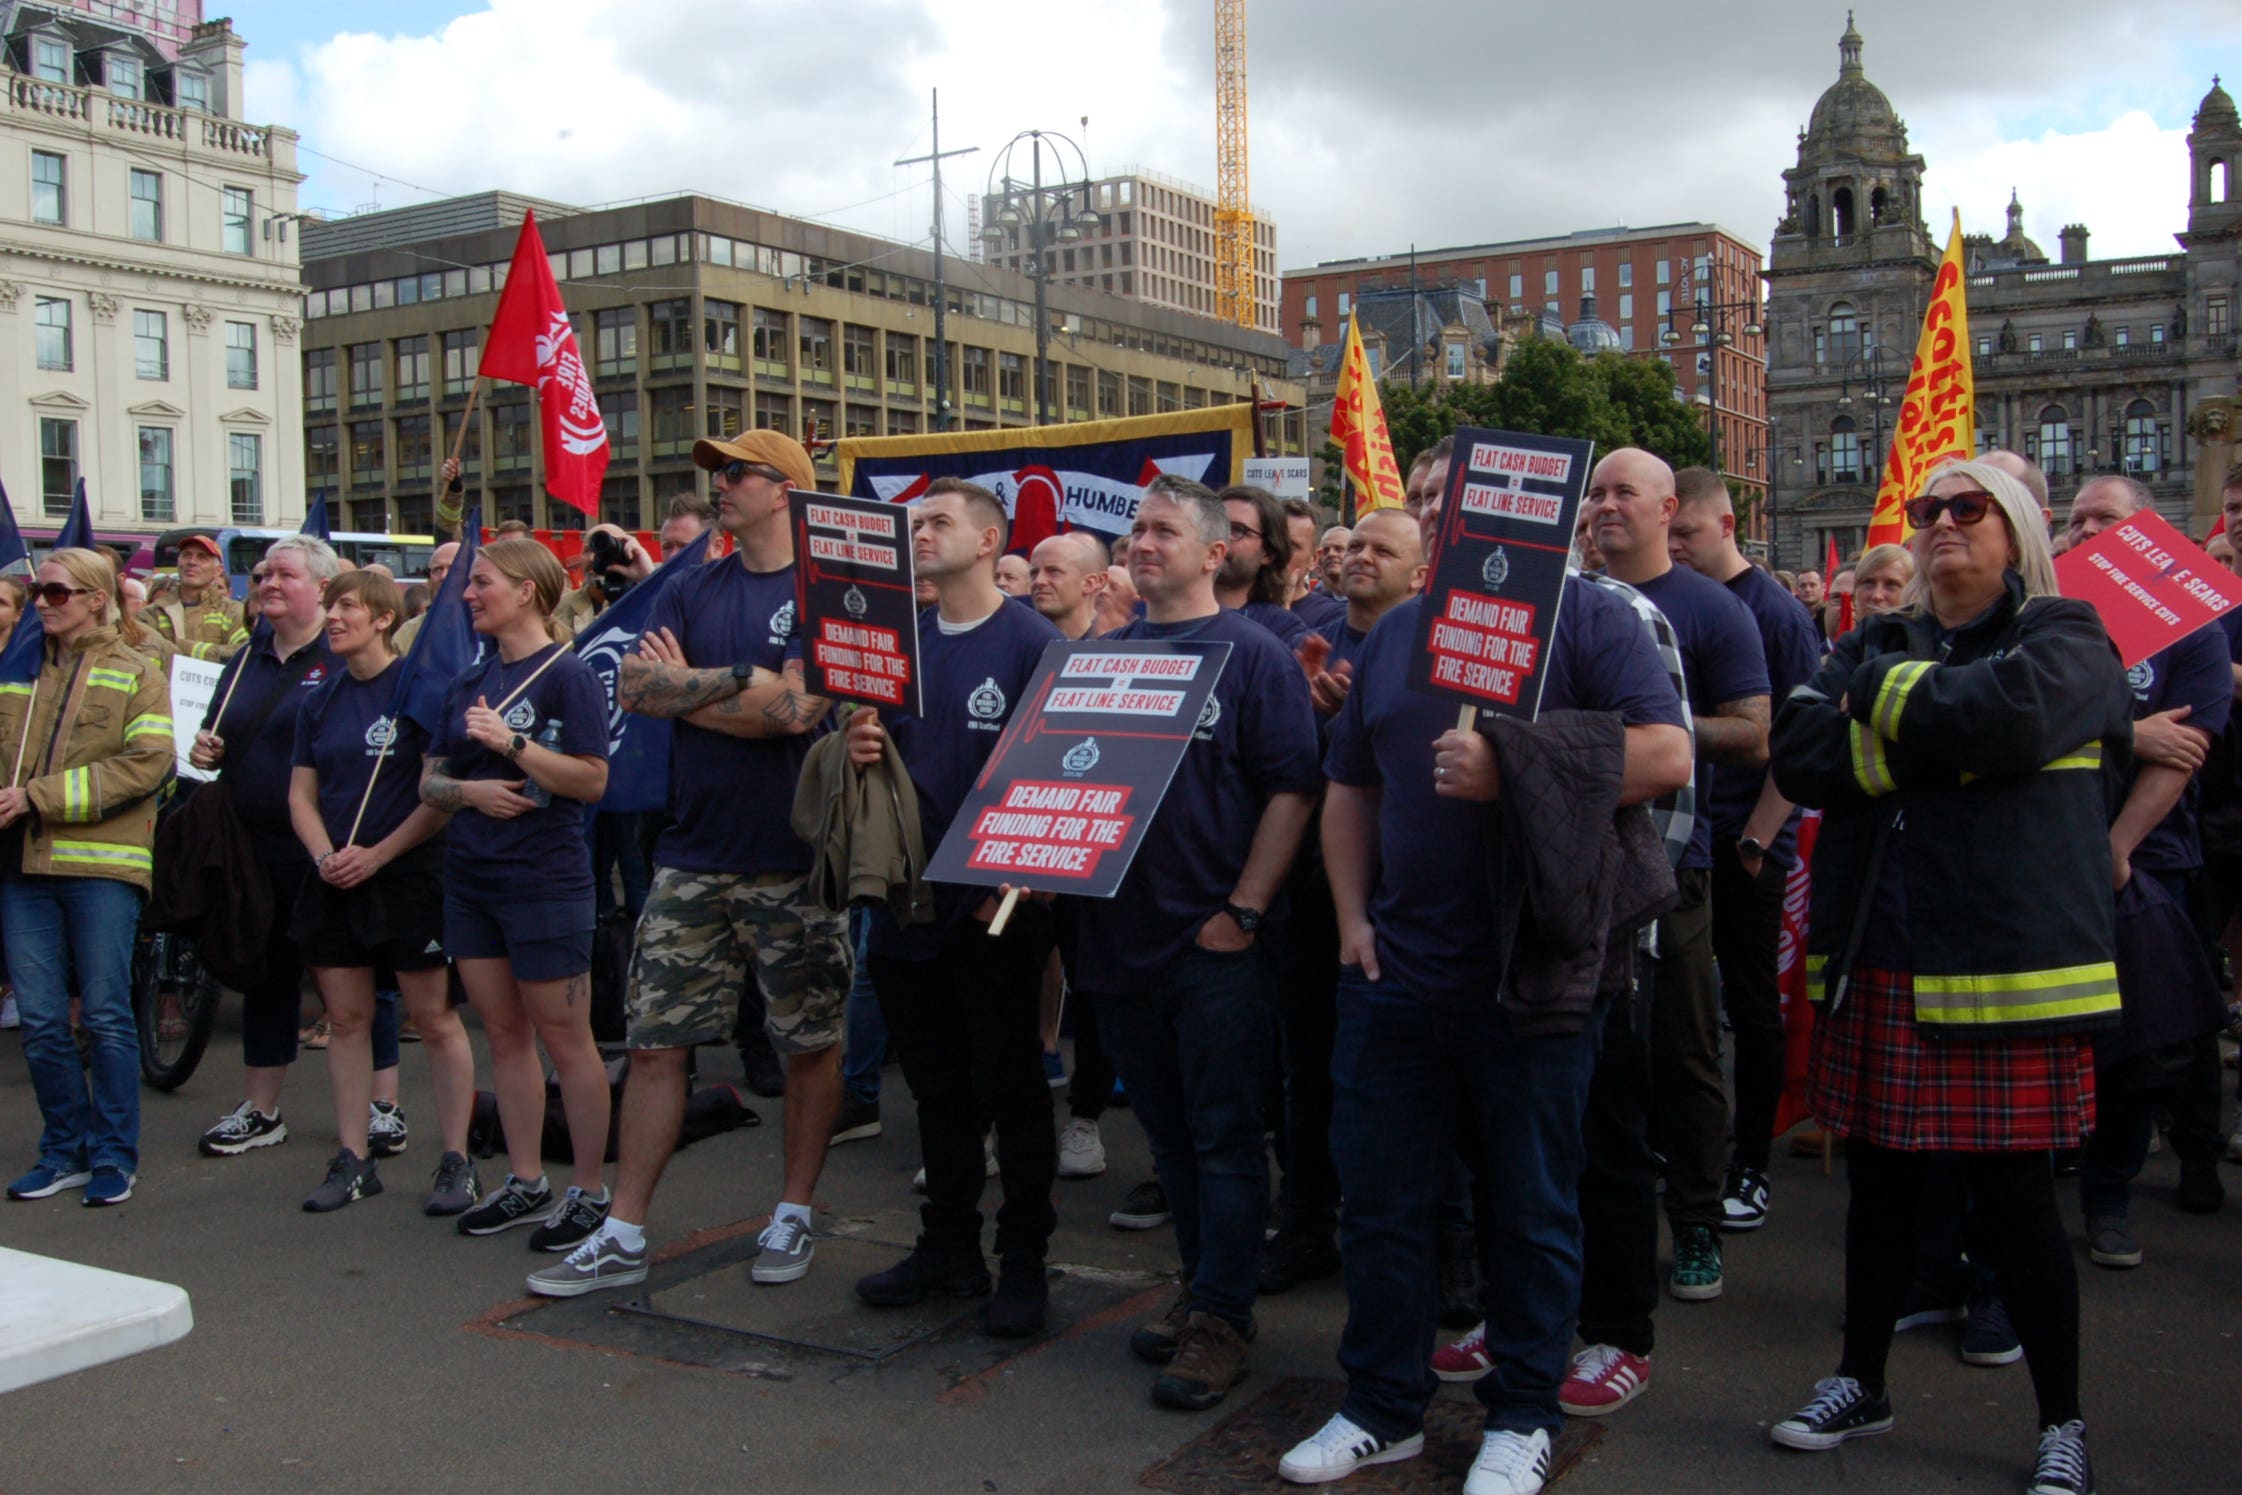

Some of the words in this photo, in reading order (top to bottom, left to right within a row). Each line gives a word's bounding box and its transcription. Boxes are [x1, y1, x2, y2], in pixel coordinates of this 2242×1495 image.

[1287, 468, 1307, 478] SCARS
[1474, 448, 1498, 468] FLAT
[1500, 452, 1526, 472] CASH
[1528, 454, 1567, 477] BUDGET
[1066, 486, 1139, 519] HUMBE
[1466, 488, 1490, 508] FLAT
[1492, 492, 1514, 512] LINE
[1516, 495, 1558, 519] SERVICE
[810, 509, 830, 524] FLAT
[834, 512, 856, 528] CASH
[858, 515, 891, 532] BUDGET
[814, 540, 833, 555] FLAT
[837, 543, 855, 559] LINE
[858, 546, 894, 566] SERVICE
[2116, 525, 2153, 552] CUTS
[2184, 578, 2230, 612] SCARS
[2088, 552, 2112, 570] STOP
[2107, 568, 2130, 586] FIRE
[2124, 582, 2162, 610] SERVICE
[2154, 606, 2181, 626] CUTS
[1448, 596, 1500, 628] DEMAND
[1499, 606, 1528, 634] FAIR
[825, 622, 868, 648] DEMAND
[870, 630, 895, 653] FAIR
[1432, 624, 1484, 656] FUNDING
[1483, 634, 1508, 662] FOR
[1509, 640, 1534, 668] THE
[818, 644, 862, 669] FUNDING
[863, 652, 884, 674] FOR
[884, 656, 906, 678] THE
[1068, 658, 1102, 673] FLAT
[1102, 658, 1138, 674] CASH
[1140, 659, 1195, 676] BUDGET
[1436, 656, 1464, 684] FIRE
[1464, 662, 1514, 696] SERVICE
[180, 670, 202, 684] CUTS
[828, 668, 852, 690] FIRE
[853, 672, 896, 698] SERVICE
[1051, 692, 1086, 708] FLAT
[1086, 692, 1118, 708] LINE
[1118, 694, 1178, 712] SERVICE
[1006, 786, 1080, 810] DEMAND
[1077, 790, 1122, 814] FAIR
[978, 812, 1052, 838] FUNDING
[1050, 816, 1088, 841] FOR
[1087, 820, 1124, 844] THE
[976, 840, 1019, 864] FIRE
[1016, 842, 1092, 871] SERVICE
